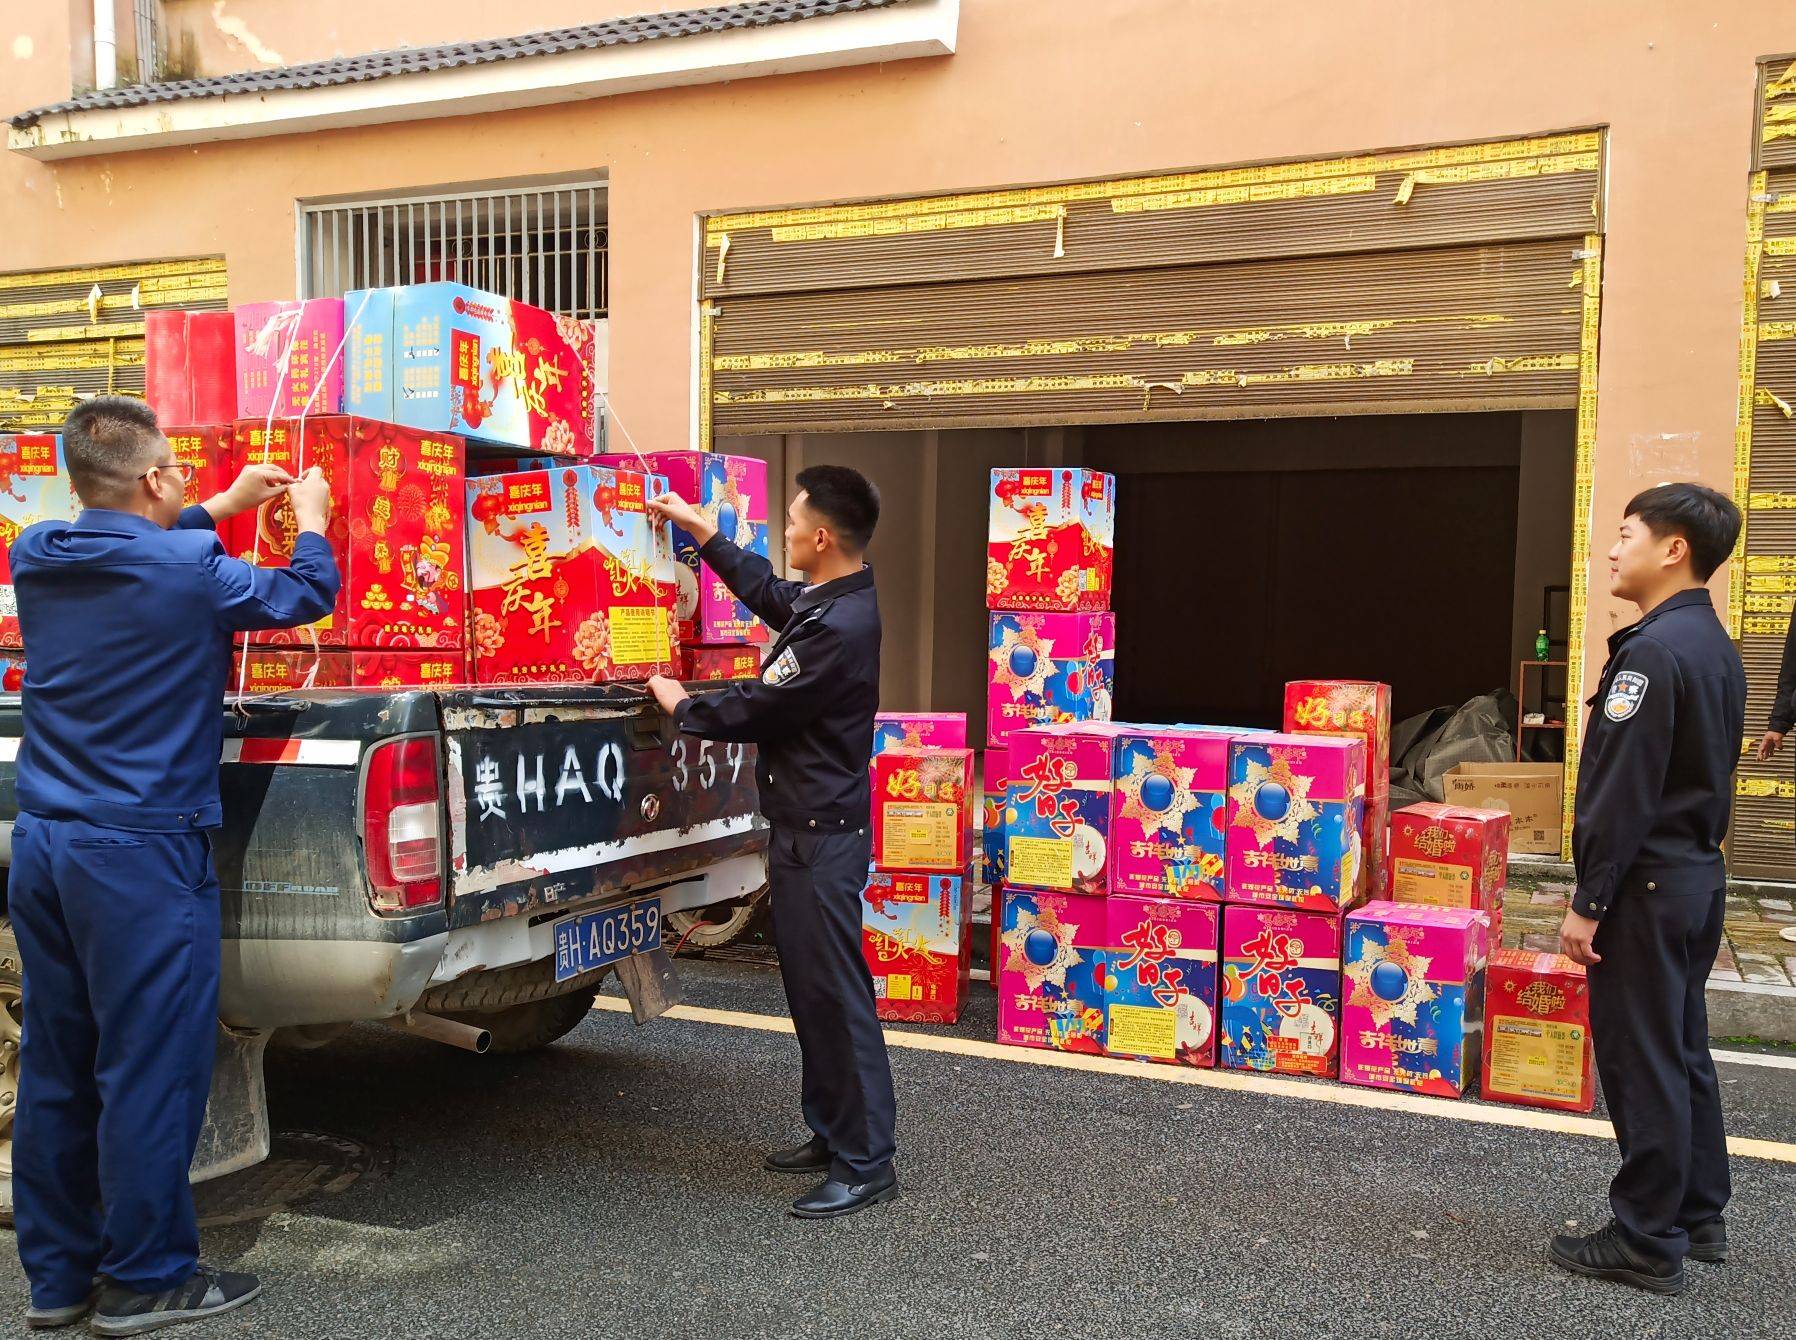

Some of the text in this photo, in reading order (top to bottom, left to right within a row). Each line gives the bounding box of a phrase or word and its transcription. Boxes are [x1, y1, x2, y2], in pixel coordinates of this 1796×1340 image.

[459, 340, 469, 381] 喜庆年
[471, 339, 479, 387] xiqingnian
[487, 346, 569, 418] 喜庆年
[167, 437, 202, 453] 喜庆年
[250, 430, 286, 446] 喜庆年
[21, 446, 50, 460] 喜庆年
[247, 450, 290, 464] xiqingnian
[420, 440, 454, 459] 喜庆年
[417, 460, 457, 476] xiqingnian
[1023, 476, 1047, 486] 喜庆年
[509, 483, 543, 499] 喜庆年
[619, 482, 641, 497] 喜庆年
[508, 500, 548, 513] xiqingnian
[618, 499, 644, 511] xiqingnian
[1008, 502, 1053, 583] 喜庆年
[501, 521, 567, 644] 喜庆年
[251, 663, 287, 679] 喜庆年
[420, 663, 453, 678] 喜庆年
[733, 656, 754, 670] 喜庆年
[474, 740, 744, 823] 贵HAQ 359
[544, 882, 567, 904] 日产
[895, 882, 923, 893] 喜庆年
[893, 894, 926, 903] xiqingnian
[558, 905, 660, 972] 贵H·AQ359
